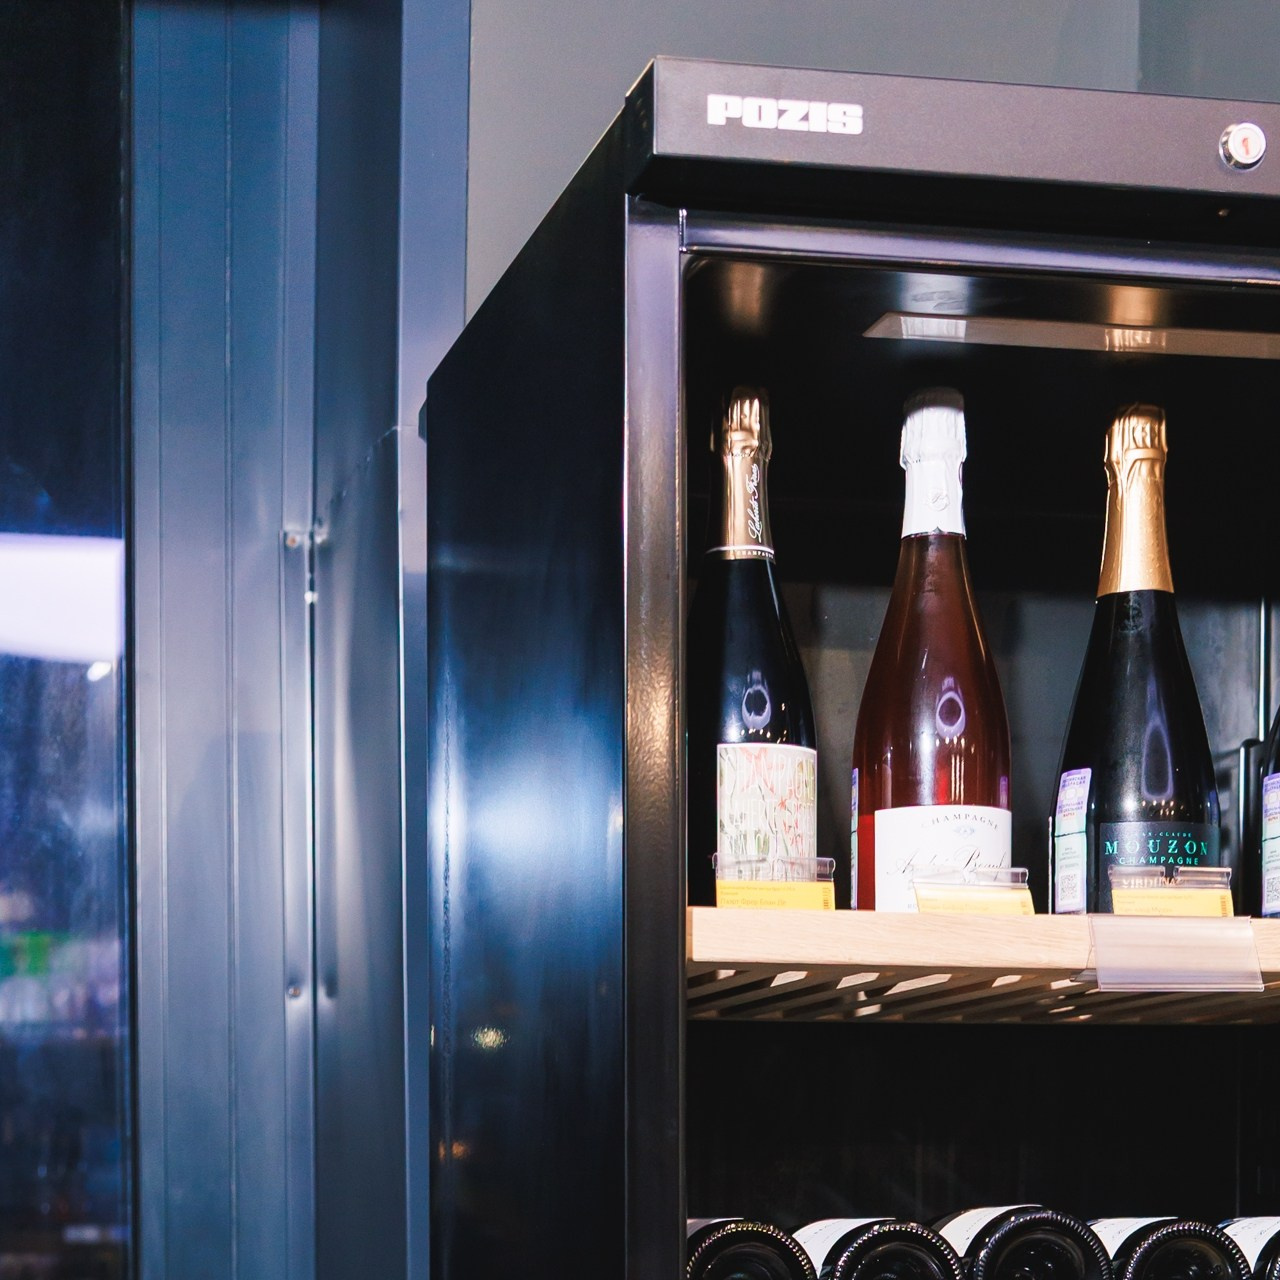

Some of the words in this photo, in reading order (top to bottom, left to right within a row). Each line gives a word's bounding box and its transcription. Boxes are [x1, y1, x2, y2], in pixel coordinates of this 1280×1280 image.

[706, 93, 864, 136] POZIS
[1104, 839, 1208, 856] MOUZON
[1118, 856, 1199, 865] CHAMPAGNE
